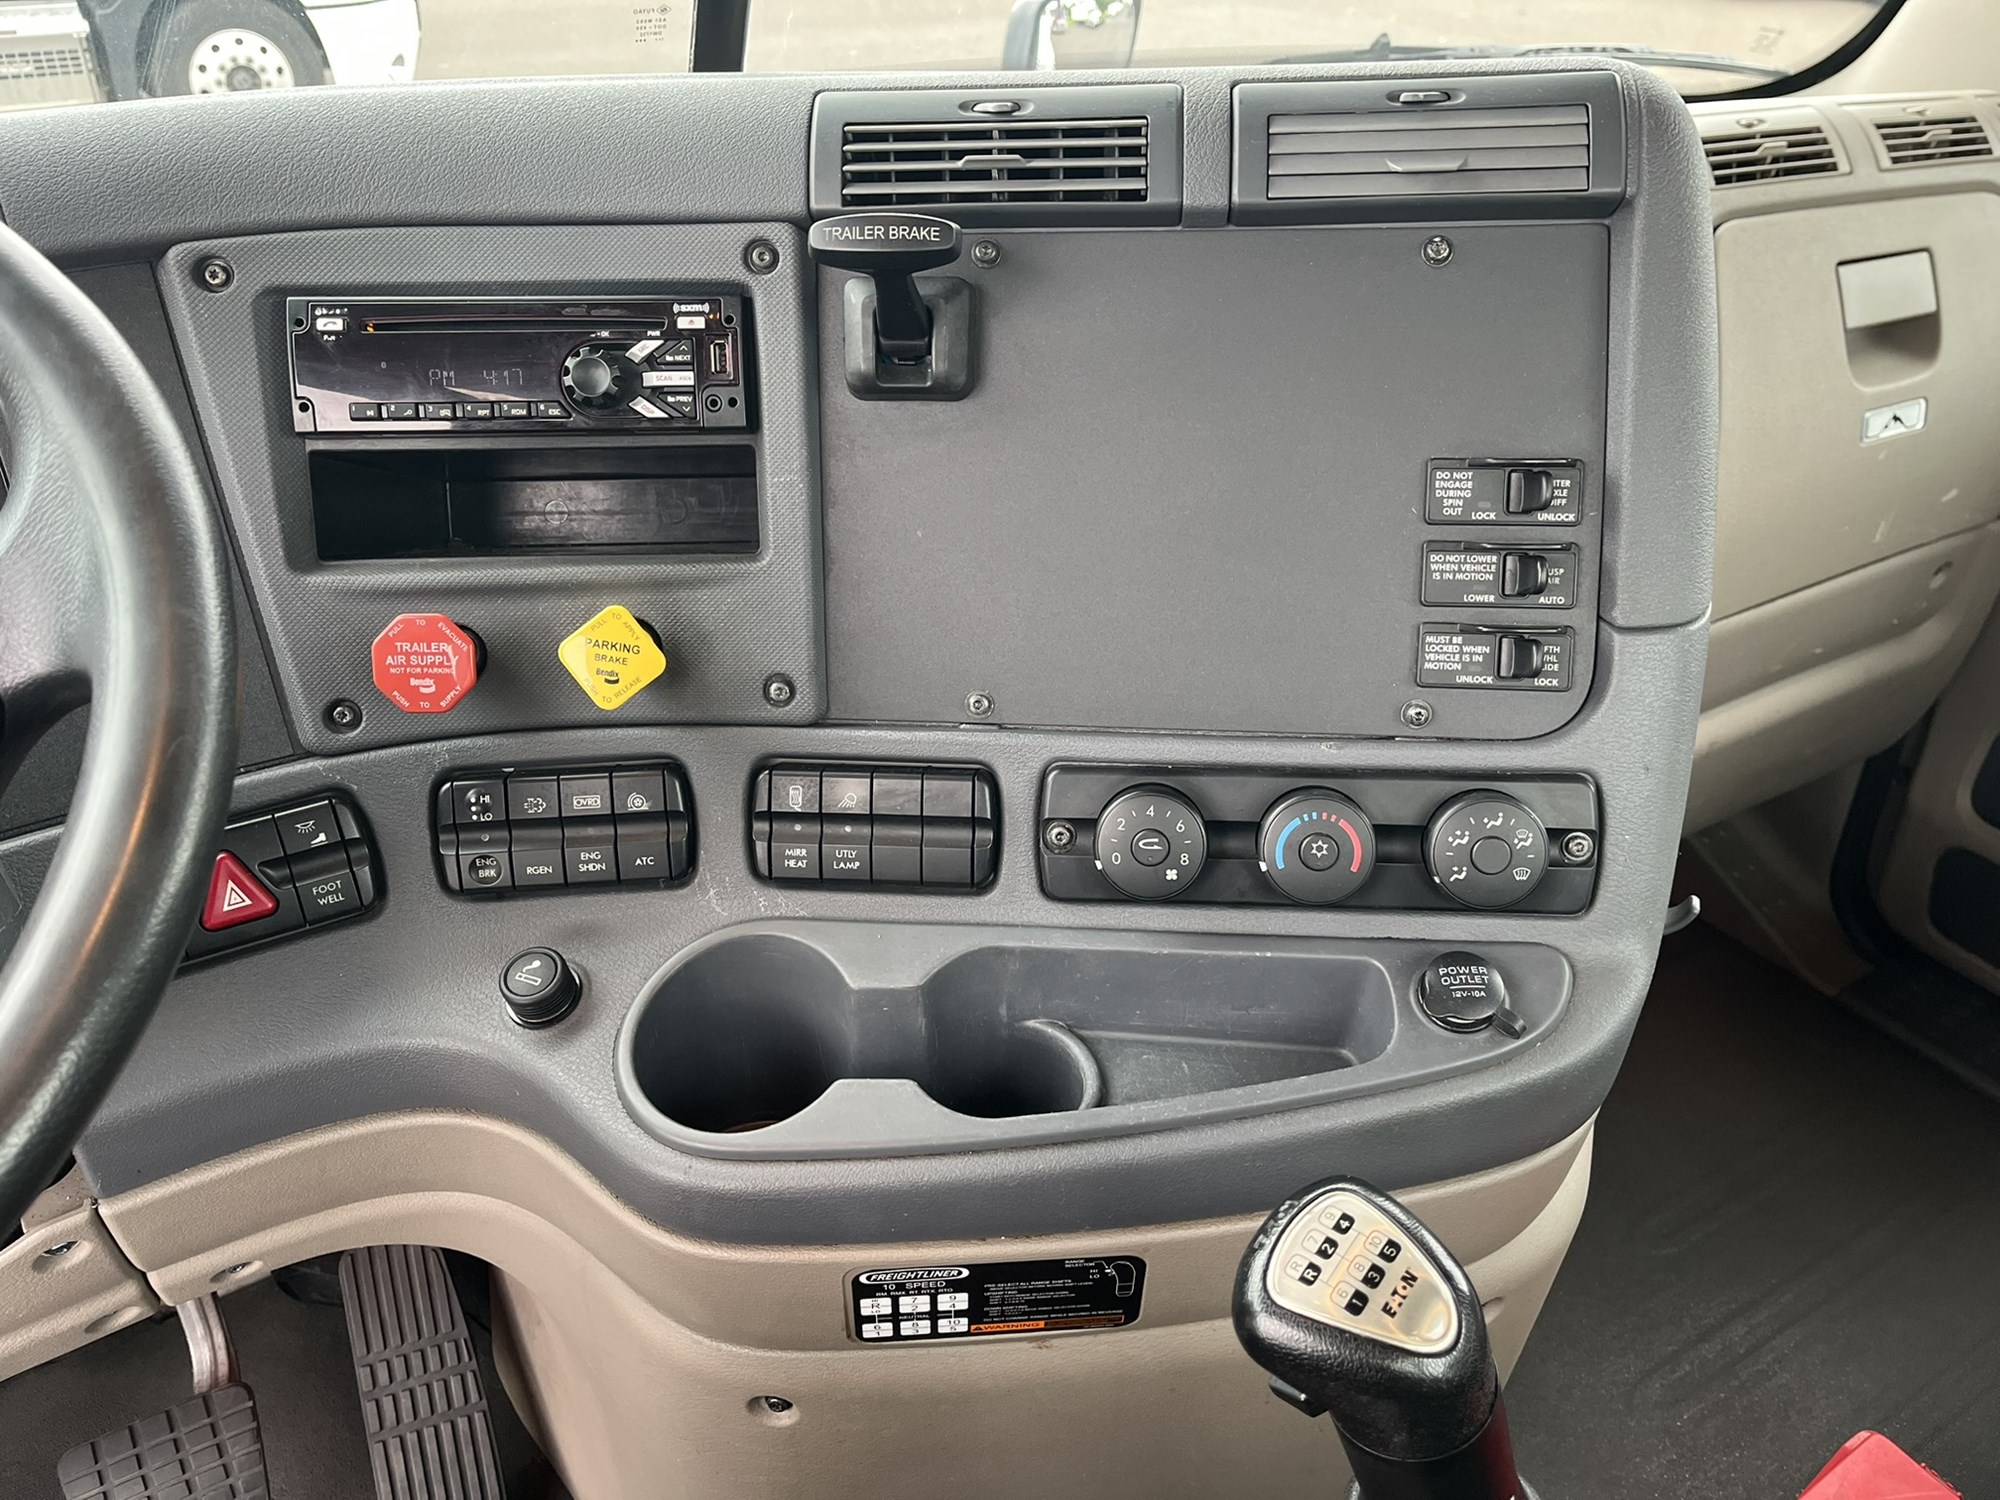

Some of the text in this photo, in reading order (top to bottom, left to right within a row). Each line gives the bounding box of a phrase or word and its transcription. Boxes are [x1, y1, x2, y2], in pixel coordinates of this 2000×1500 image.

[822, 226, 940, 241] TRAILER BRAKE
[429, 368, 523, 386] PM 4:17
[1436, 471, 1450, 479] DO
[1472, 512, 1496, 520] LOCK
[1538, 513, 1576, 521] UNLOCK
[1464, 594, 1495, 602] LOWER
[1539, 596, 1565, 604] AUTO
[591, 620, 607, 631] PULL
[623, 622, 640, 640] APPLY
[388, 623, 404, 637] PULL
[437, 622, 468, 652] EVACUATE
[395, 642, 448, 652] TRAILER
[585, 638, 640, 655] PARKING
[386, 655, 459, 665] AIR SUPPLY
[594, 654, 628, 665] BRAKE
[1425, 653, 1460, 661] VEHICLE
[1424, 662, 1461, 670] MOTION
[596, 668, 619, 677] Bendix
[1456, 675, 1494, 684] UNLOCK
[1535, 678, 1559, 686] LOCK
[584, 678, 599, 696] PUSH
[614, 676, 642, 698] RELEASE
[392, 691, 410, 708] PUSH
[440, 684, 462, 707] SUPPLY
[480, 795, 490, 804] HI
[575, 797, 600, 808] OVRD
[1146, 805, 1154, 817] 4
[480, 812, 492, 821] LO
[1117, 818, 1125, 831] 2
[1176, 820, 1185, 832] 6
[581, 851, 601, 861] ENG
[785, 848, 807, 857] MIRR
[835, 850, 857, 859] UTLY
[476, 857, 497, 867] ENG
[635, 857, 654, 866] ATC
[1112, 852, 1121, 864] 0
[1180, 853, 1189, 865] 8
[578, 862, 606, 872] SHDN
[784, 859, 807, 868] HEAT
[833, 860, 860, 870] LAMP
[478, 868, 496, 878] BRK
[526, 866, 552, 875] RGEN
[312, 880, 342, 896] FOOT
[317, 892, 345, 906] WELL
[1438, 966, 1488, 976] POWER
[1441, 975, 1489, 986] OUTLET
[1340, 1219, 1350, 1228] 4
[1307, 1236, 1318, 1244] 7
[1369, 1236, 1382, 1249] 10
[1322, 1243, 1335, 1255] 2
[1383, 1245, 1396, 1256] 5
[1290, 1261, 1303, 1272] R
[1354, 1263, 1365, 1272] 8
[870, 1269, 958, 1282] FREIGHTLINER
[1304, 1269, 1318, 1281] R
[1368, 1271, 1380, 1282] 3
[905, 1281, 946, 1289] SPEED
[1337, 1288, 1348, 1298] 6
[1352, 1298, 1363, 1307] 1
